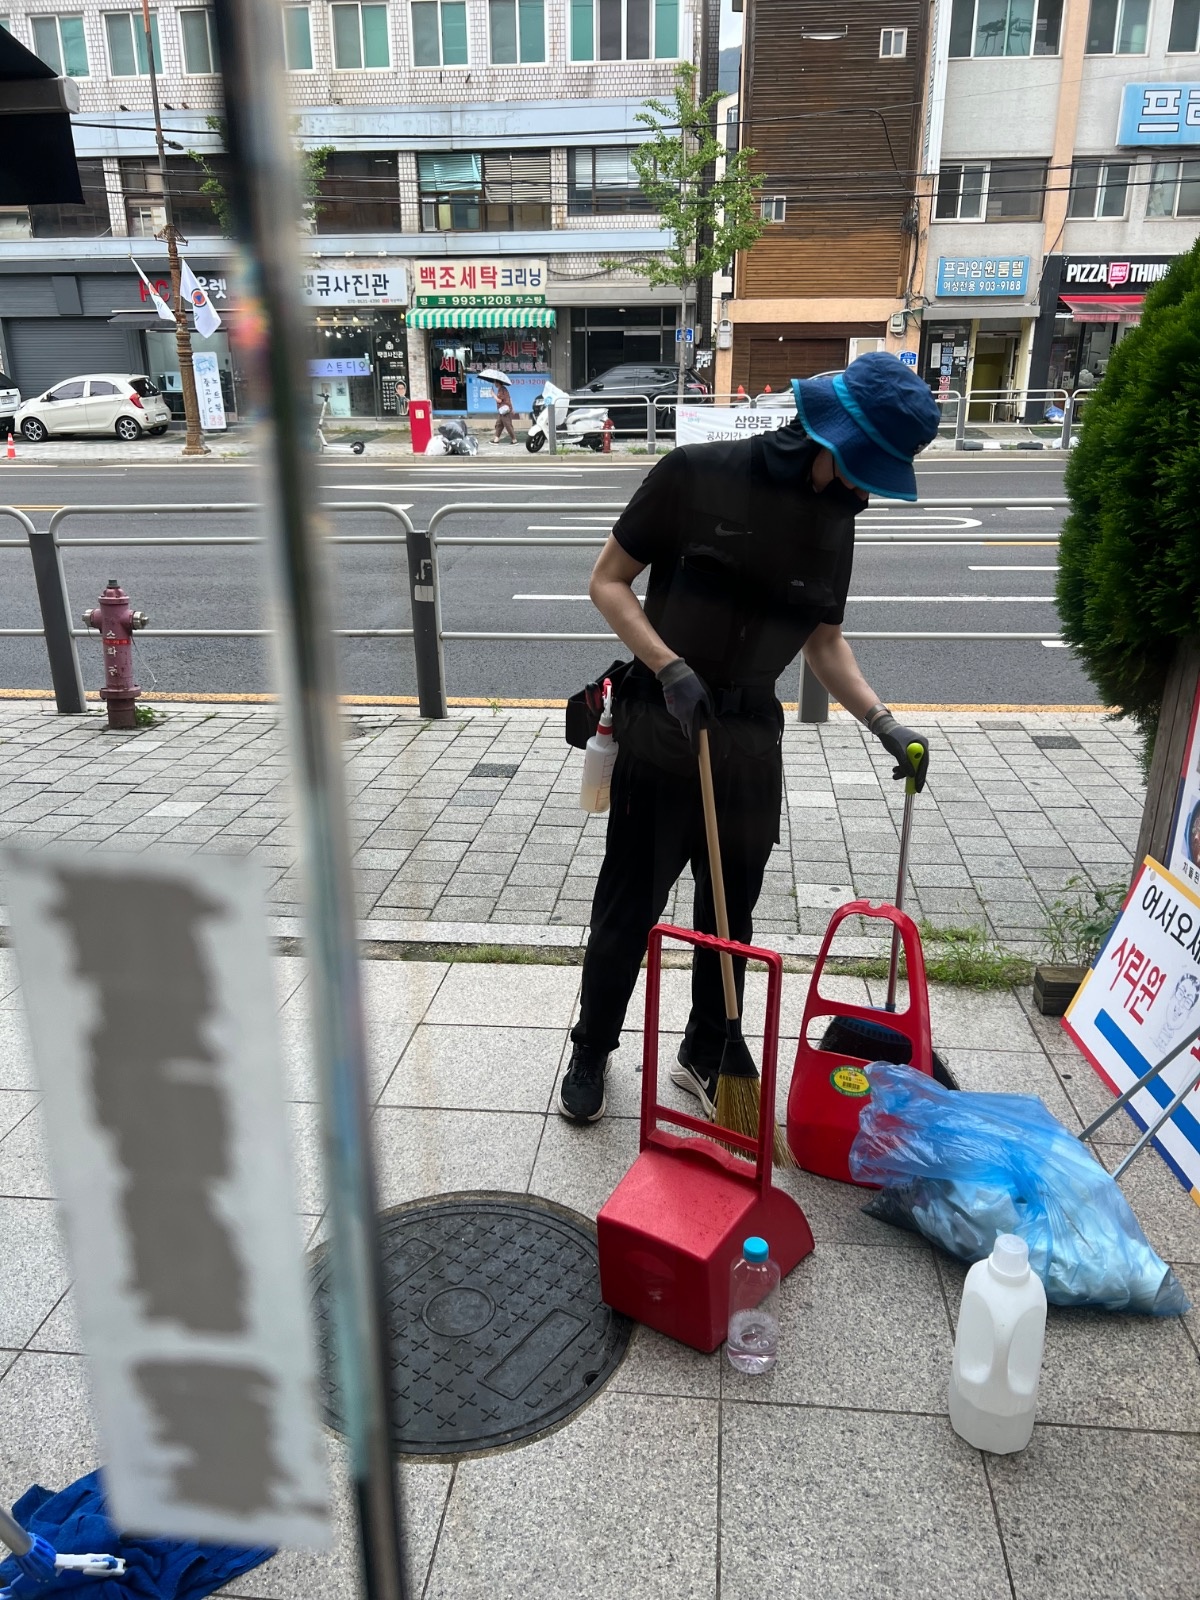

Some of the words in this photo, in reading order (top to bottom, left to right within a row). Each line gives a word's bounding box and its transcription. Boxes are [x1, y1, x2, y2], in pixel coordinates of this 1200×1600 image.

[943, 260, 1024, 278] 프라임원룸텔
[1066, 264, 1107, 283] PIZZA
[1130, 264, 1170, 283] THIN
[943, 281, 976, 292] 여성전용
[979, 280, 1021, 291] 903-9188
[452, 296, 512, 305] 993-1208
[515, 296, 542, 304] 무스탕
[327, 361, 366, 373] 스튜디오
[735, 416, 772, 429] 삼양로
[776, 416, 796, 428] 가
[1109, 937, 1167, 1026] 사리원
